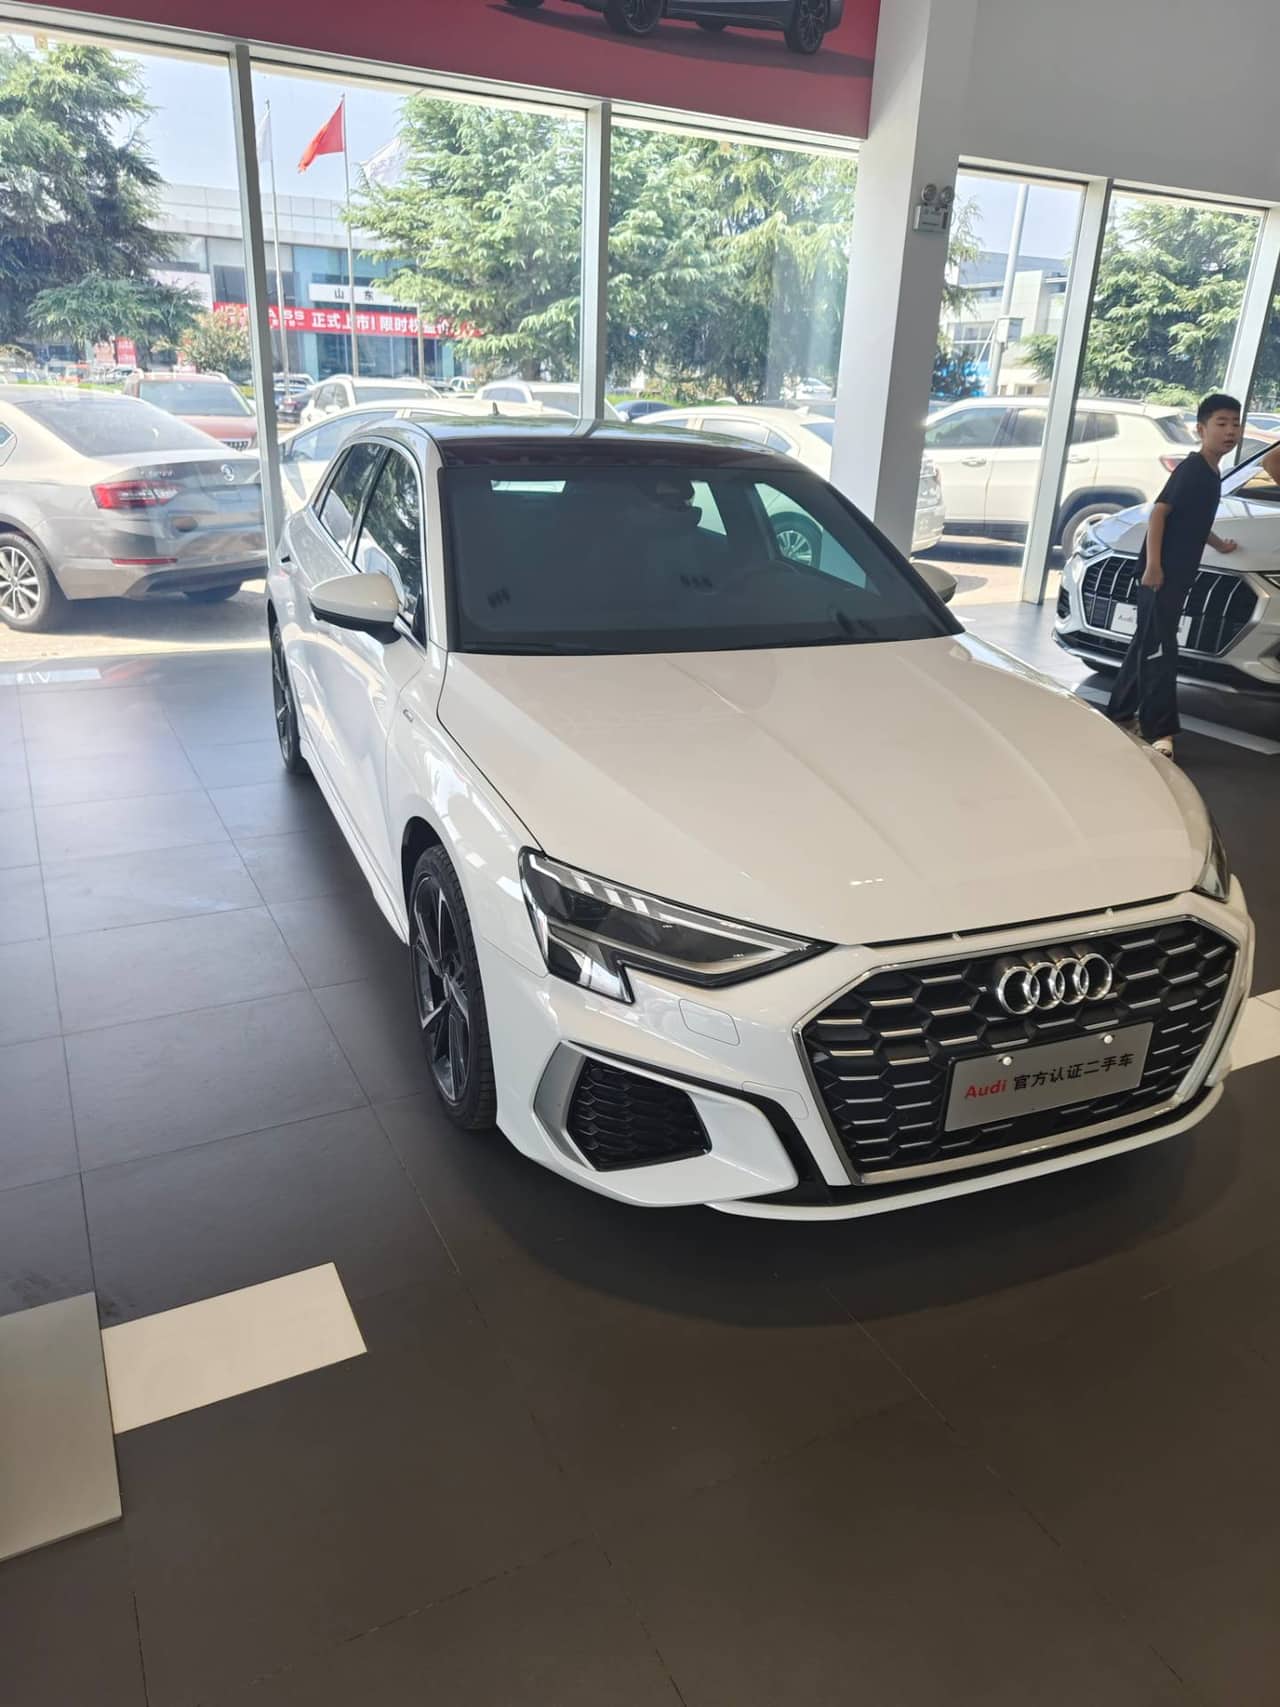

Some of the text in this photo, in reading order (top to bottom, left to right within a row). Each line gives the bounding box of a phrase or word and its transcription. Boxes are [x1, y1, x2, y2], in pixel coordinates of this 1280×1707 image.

[965, 1053, 1134, 1099] Audi 官方认证二手车
